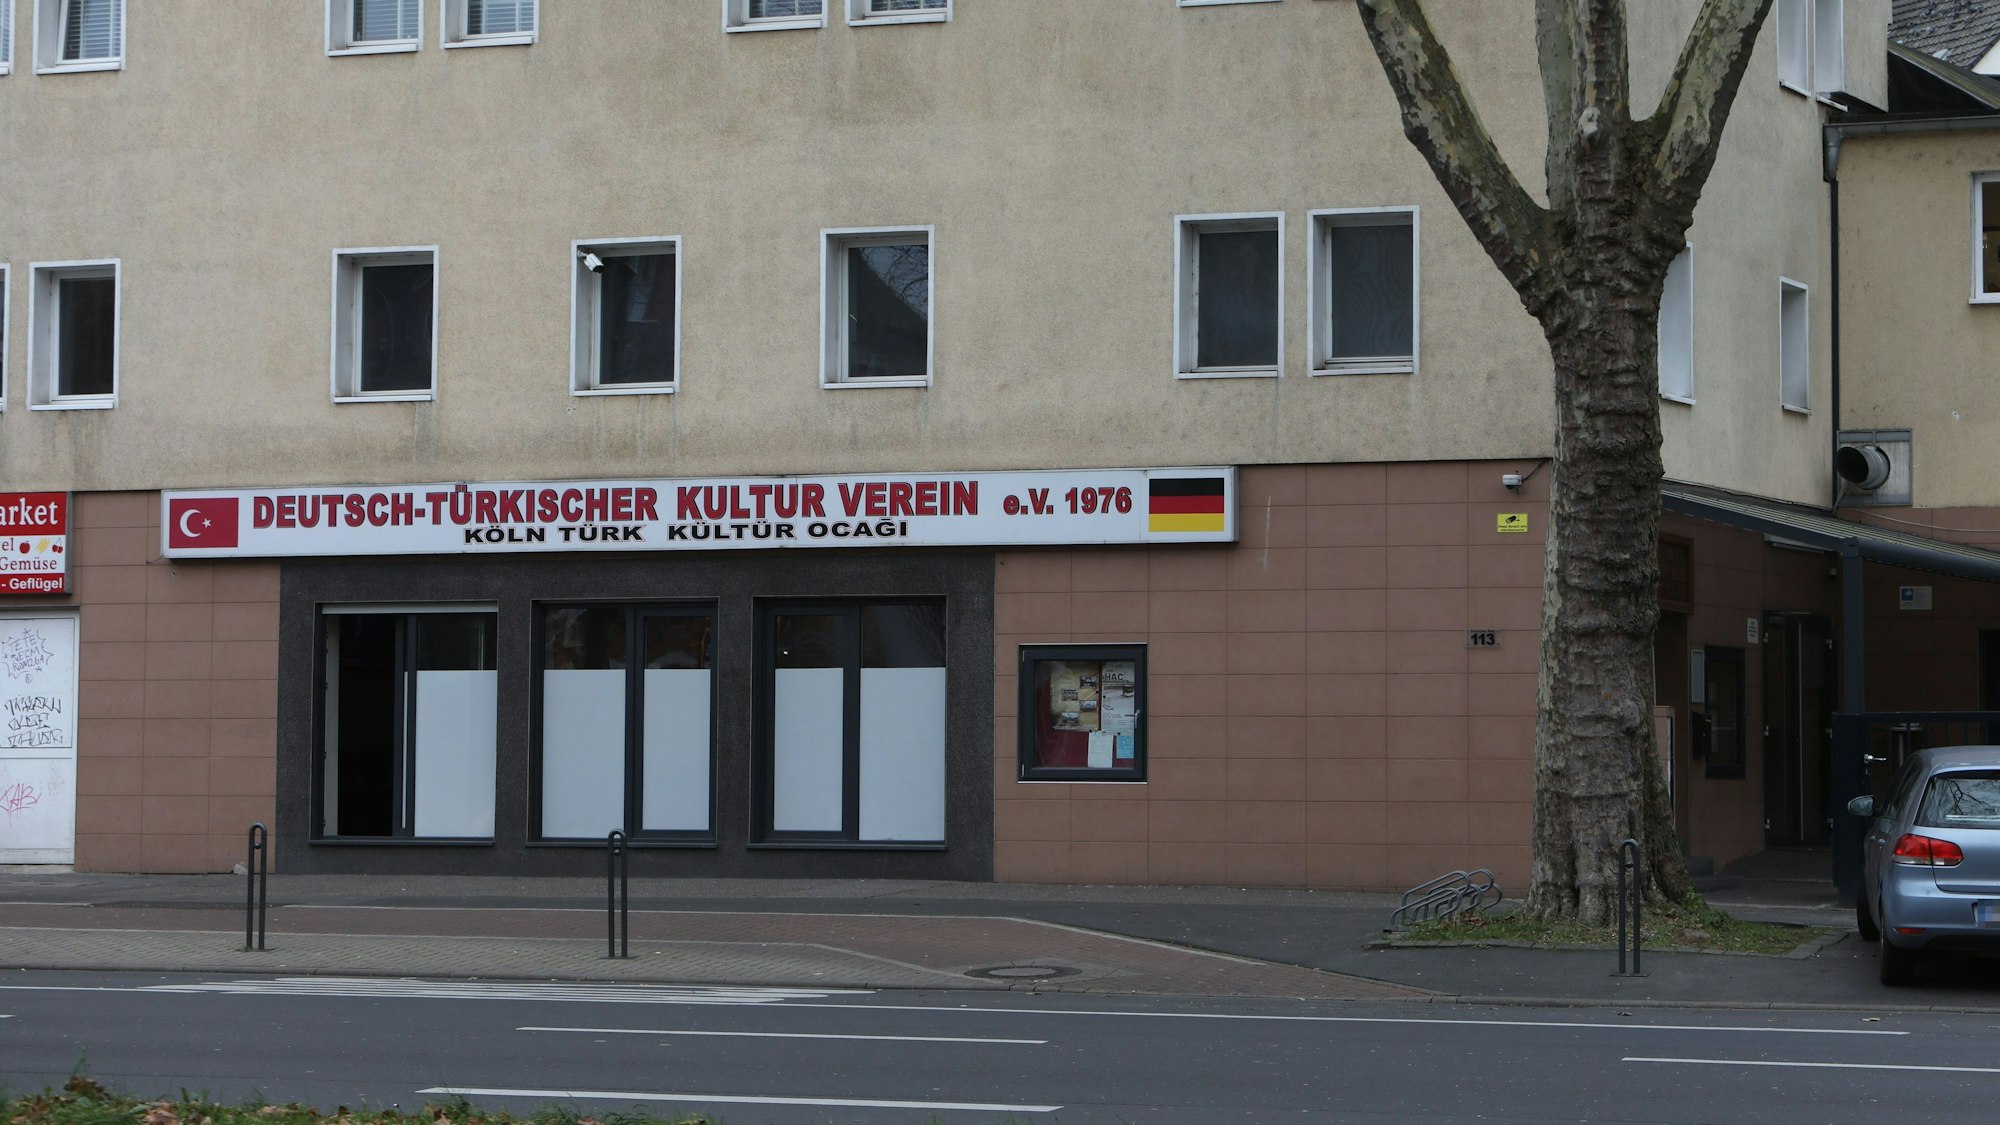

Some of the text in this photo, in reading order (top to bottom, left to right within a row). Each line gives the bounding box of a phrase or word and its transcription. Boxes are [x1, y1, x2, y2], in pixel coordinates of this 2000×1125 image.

[253, 481, 1132, 529] DEUTSCH-TÜRKISCHER KULTUR VEREIN e.V. 1976
[465, 518, 908, 544] KÖLN TÜRK KÜLTÜR OCAĞI
[0, 537, 14, 551] el
[0, 556, 57, 571] Gemüse
[9, 577, 63, 592] Geflügel
[1470, 633, 1495, 645] 113
